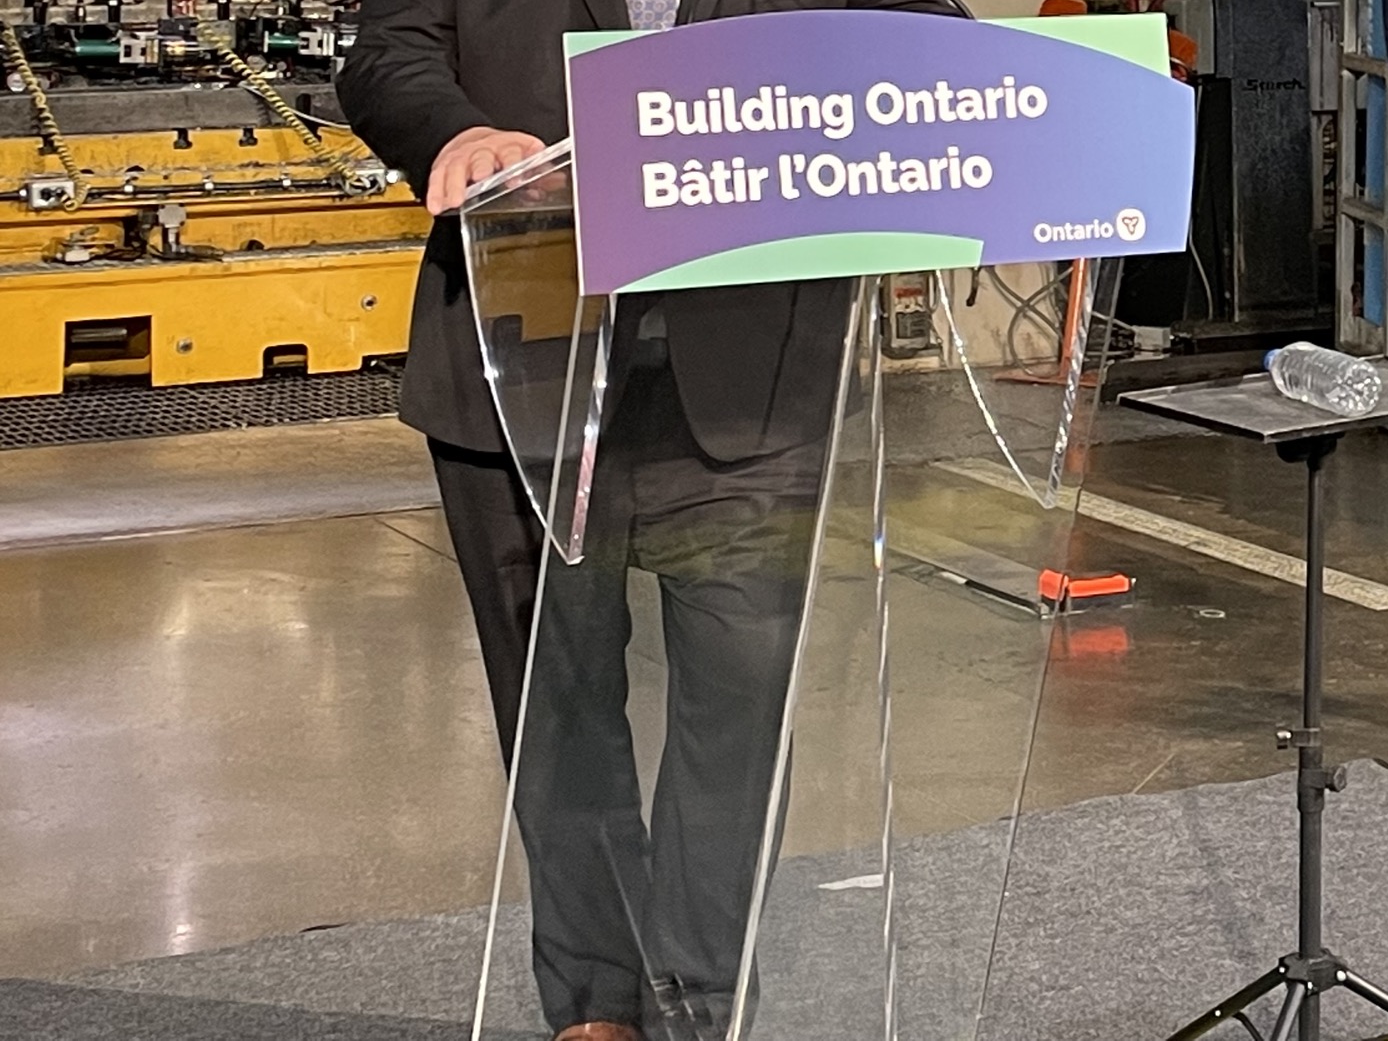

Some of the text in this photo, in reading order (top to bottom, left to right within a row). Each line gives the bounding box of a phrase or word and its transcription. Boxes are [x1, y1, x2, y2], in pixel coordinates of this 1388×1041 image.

[636, 76, 1048, 140] Building Ontario
[641, 146, 993, 208] Bâtir l'Ontario
[1033, 219, 1115, 243] Ontario
